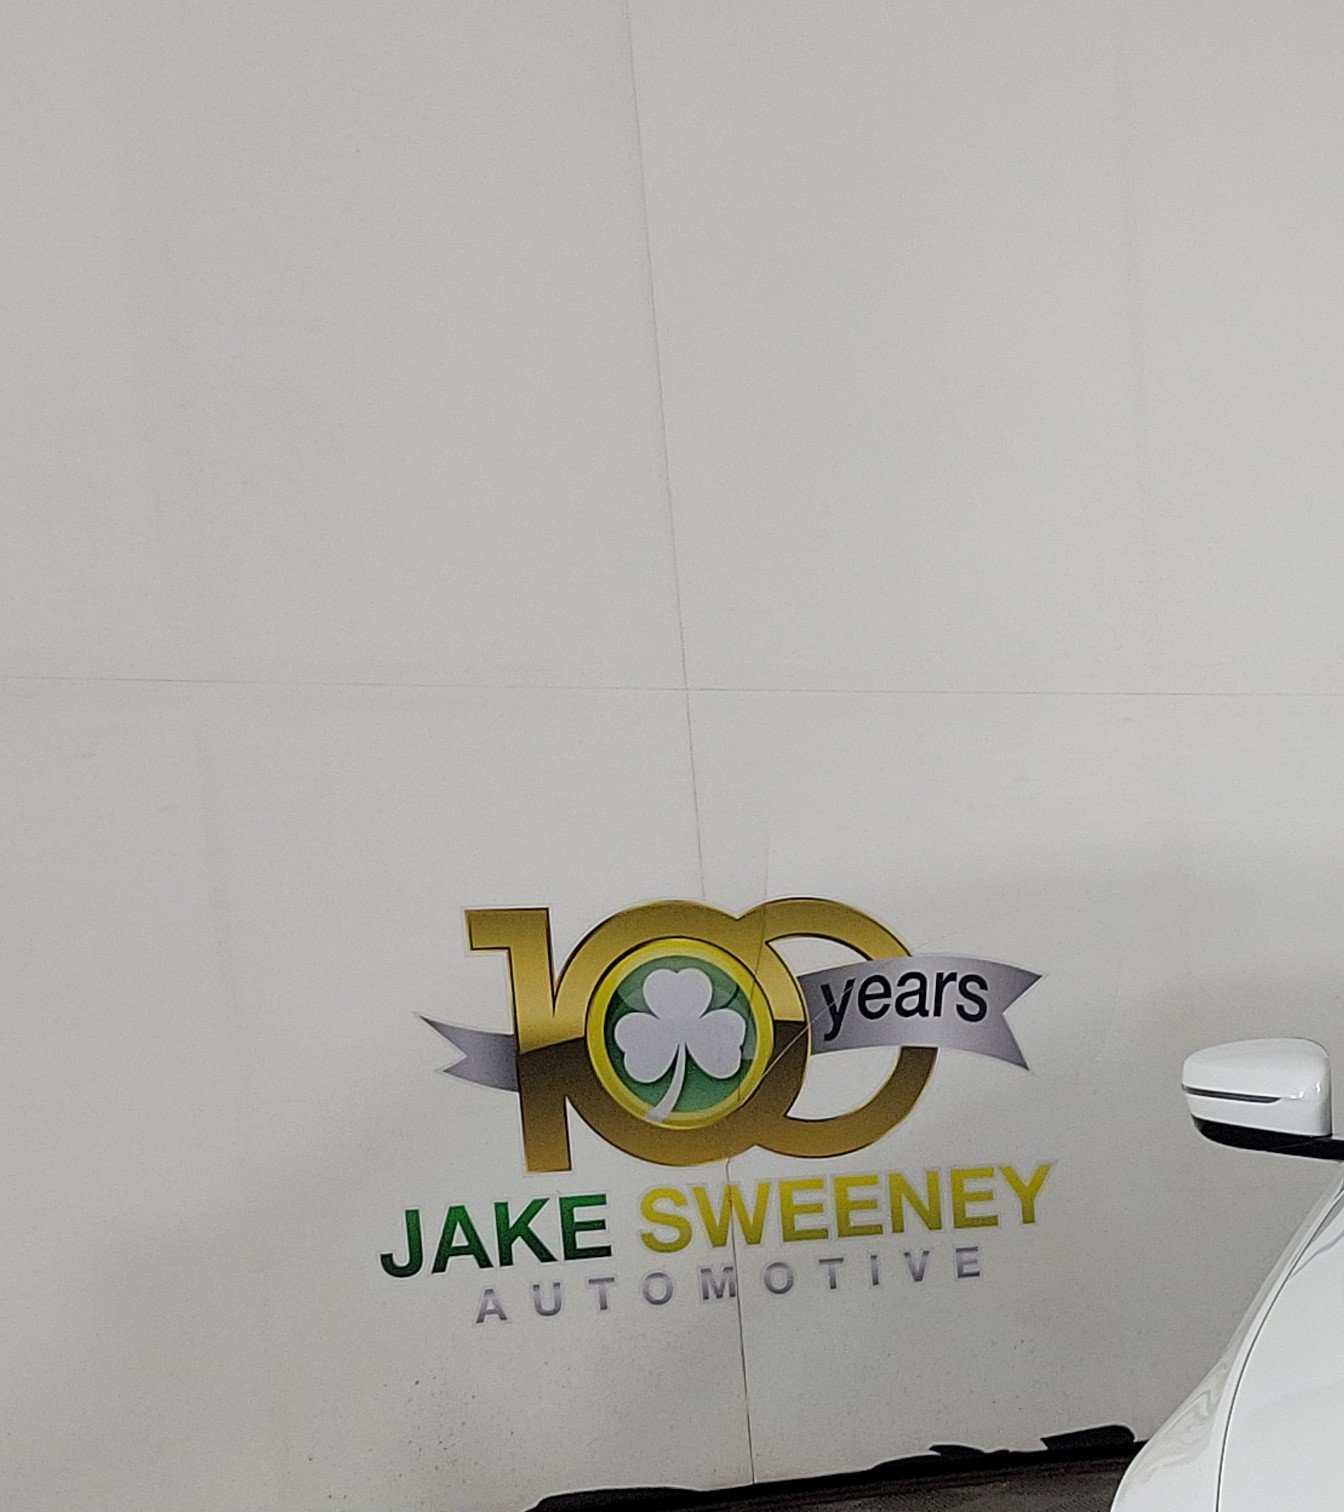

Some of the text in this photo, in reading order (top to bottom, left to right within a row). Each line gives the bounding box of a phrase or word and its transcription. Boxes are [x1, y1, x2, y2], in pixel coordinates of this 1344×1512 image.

[820, 971, 991, 1041] years
[380, 1163, 1052, 1279] JAKE SWEENEY
[475, 1246, 982, 1324] AUTOMOTIVE
